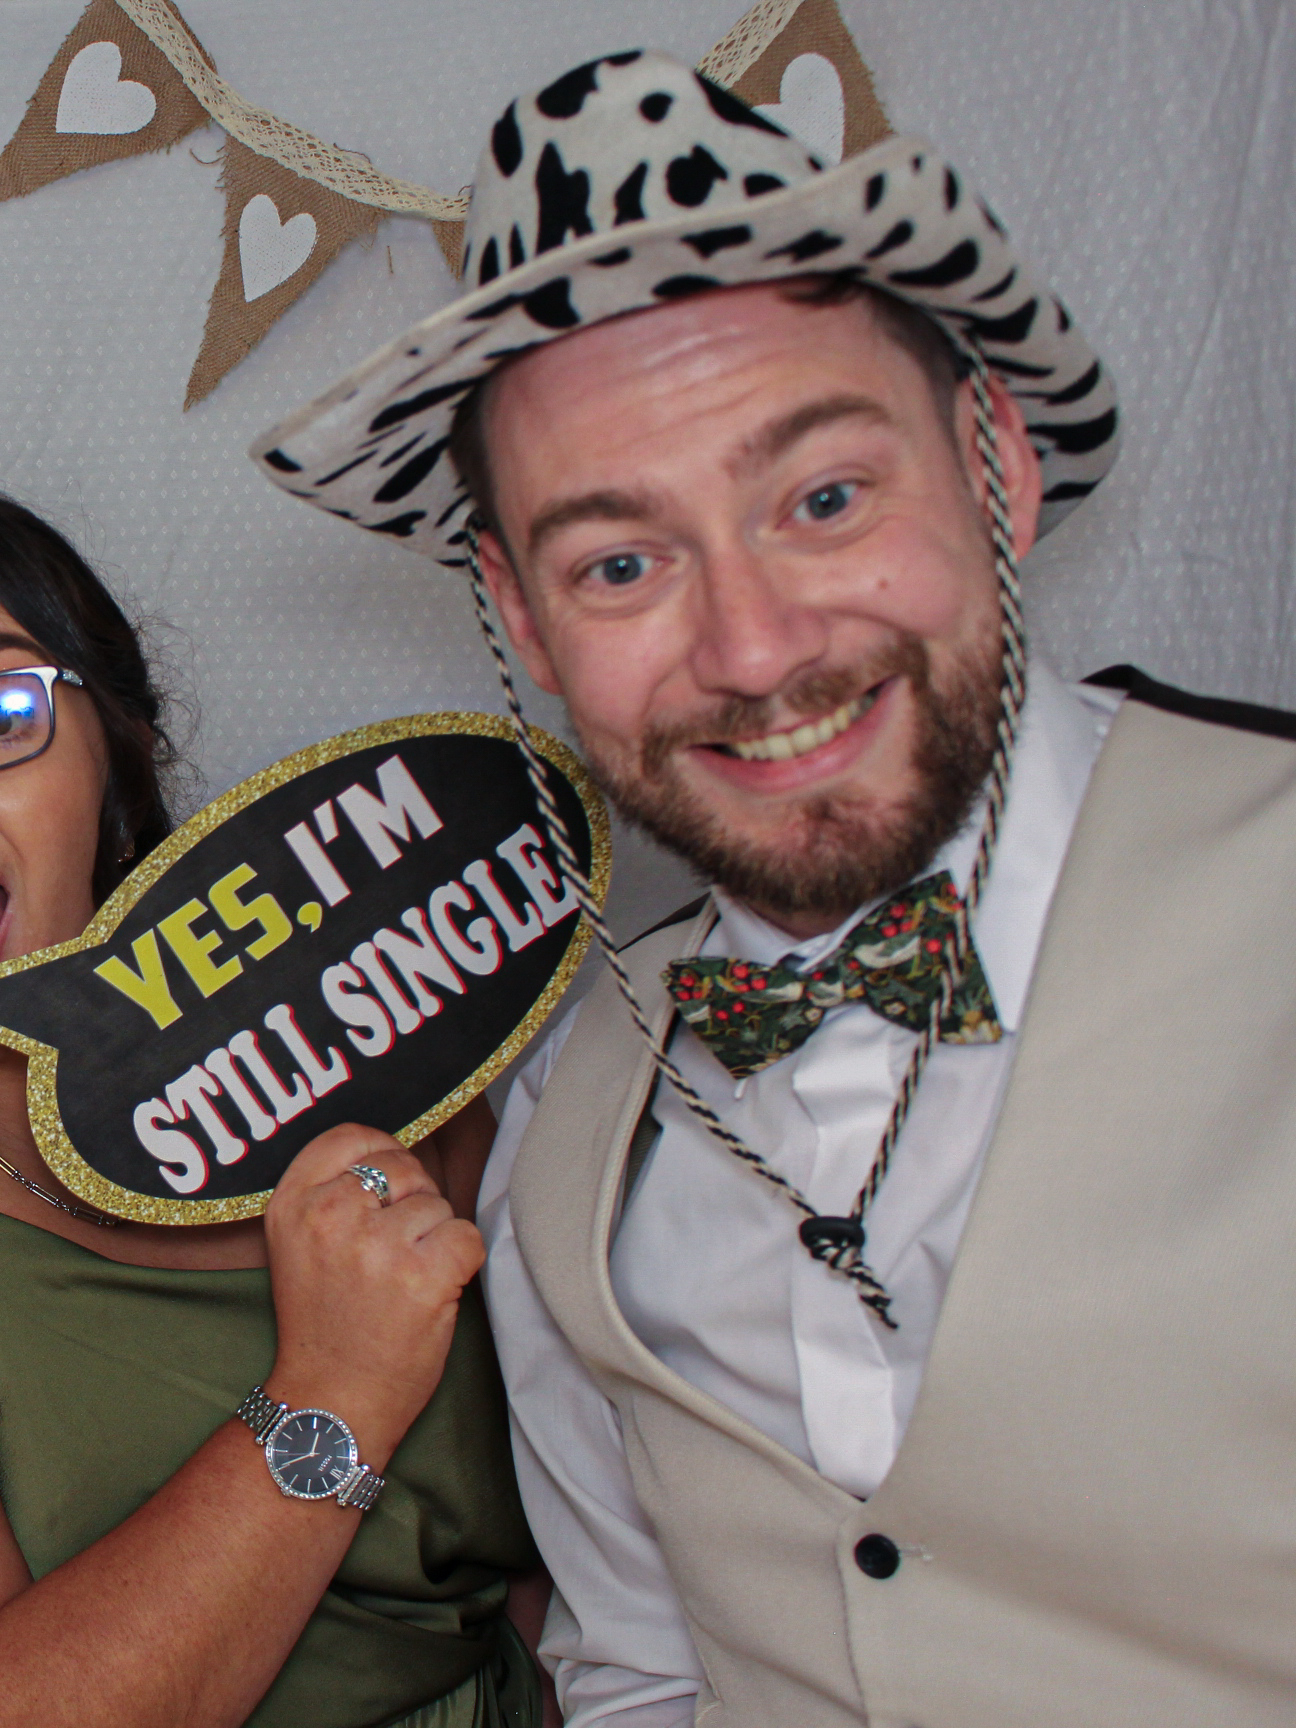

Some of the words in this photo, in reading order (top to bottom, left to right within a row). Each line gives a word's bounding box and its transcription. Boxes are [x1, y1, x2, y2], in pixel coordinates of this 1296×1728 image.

[92, 862, 323, 1031] YES,
[283, 754, 444, 907] I'M
[132, 1003, 352, 1194] STILL
[320, 823, 581, 1058] SINGLE
